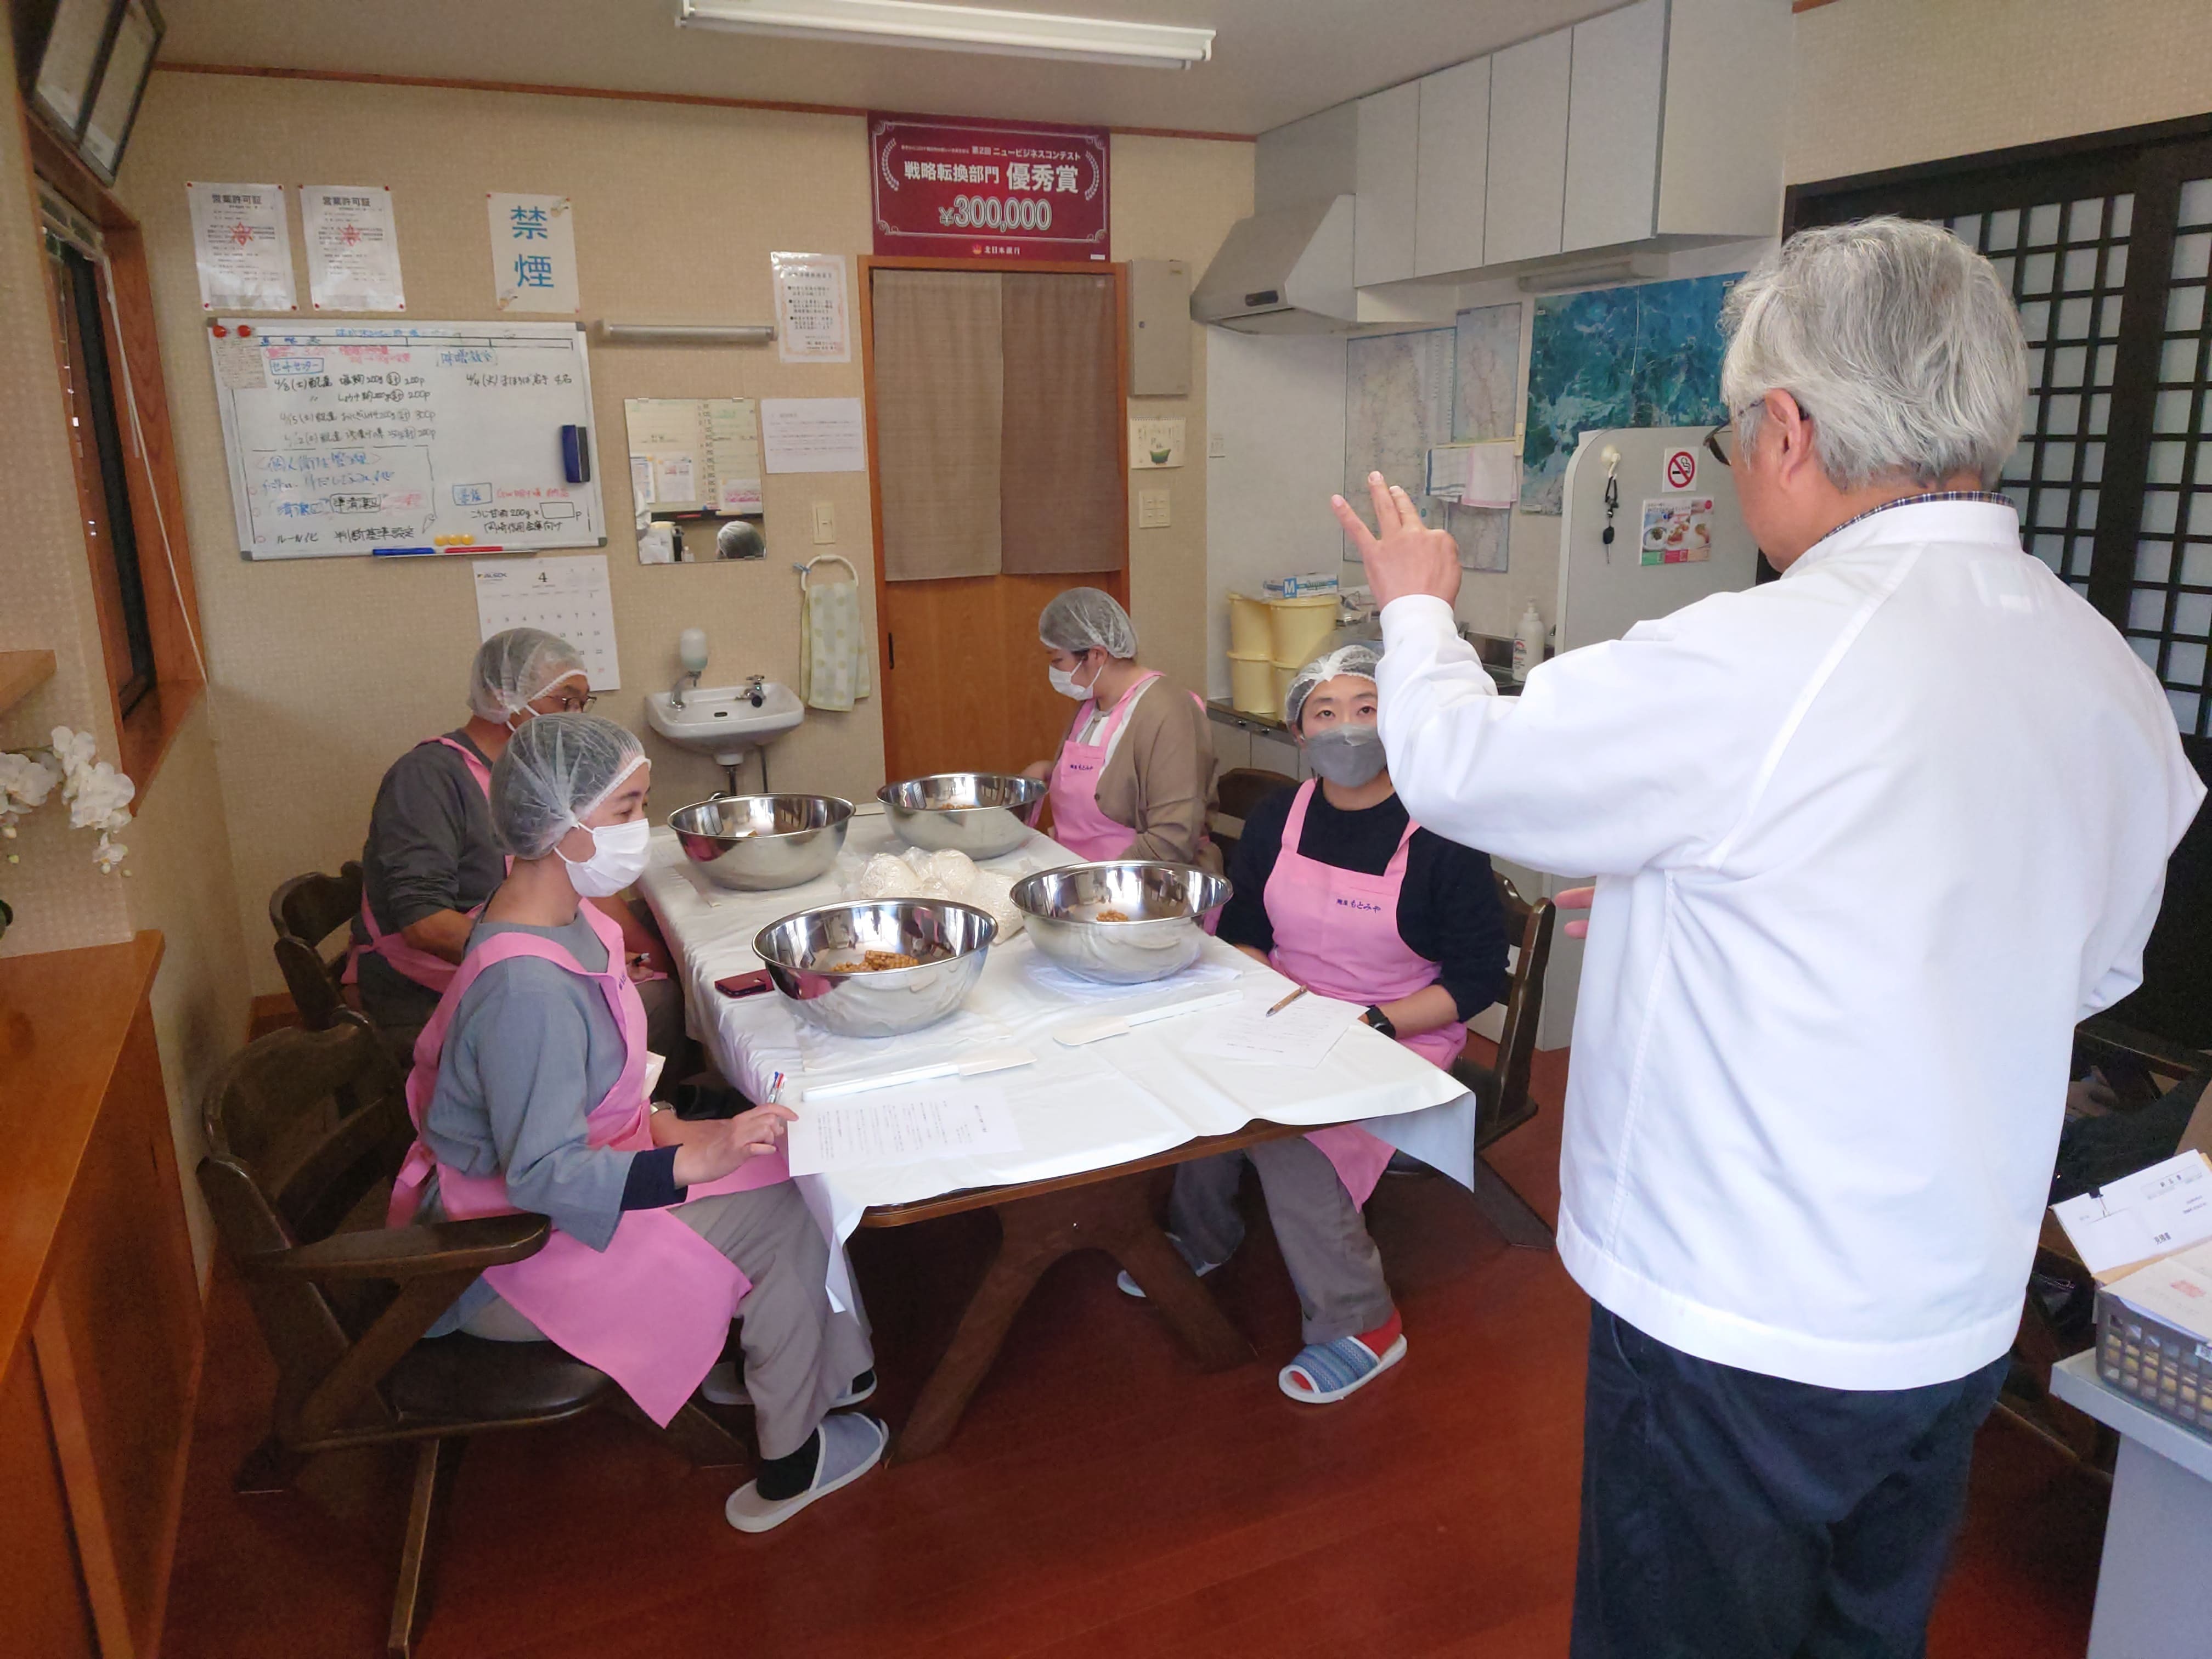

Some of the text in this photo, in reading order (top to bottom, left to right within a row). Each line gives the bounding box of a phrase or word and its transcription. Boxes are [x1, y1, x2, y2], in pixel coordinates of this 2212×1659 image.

[992, 147, 1081, 162] ニュービジネスコンテスト
[904, 160, 1079, 194] 戦略転換部門 優秀賞
[939, 194, 1052, 233] ¥300,000
[510, 205, 555, 288] 禁煙
[538, 572, 548, 583] 4
[1284, 580, 1296, 594] M
[1351, 900, 1381, 913] もとみや
